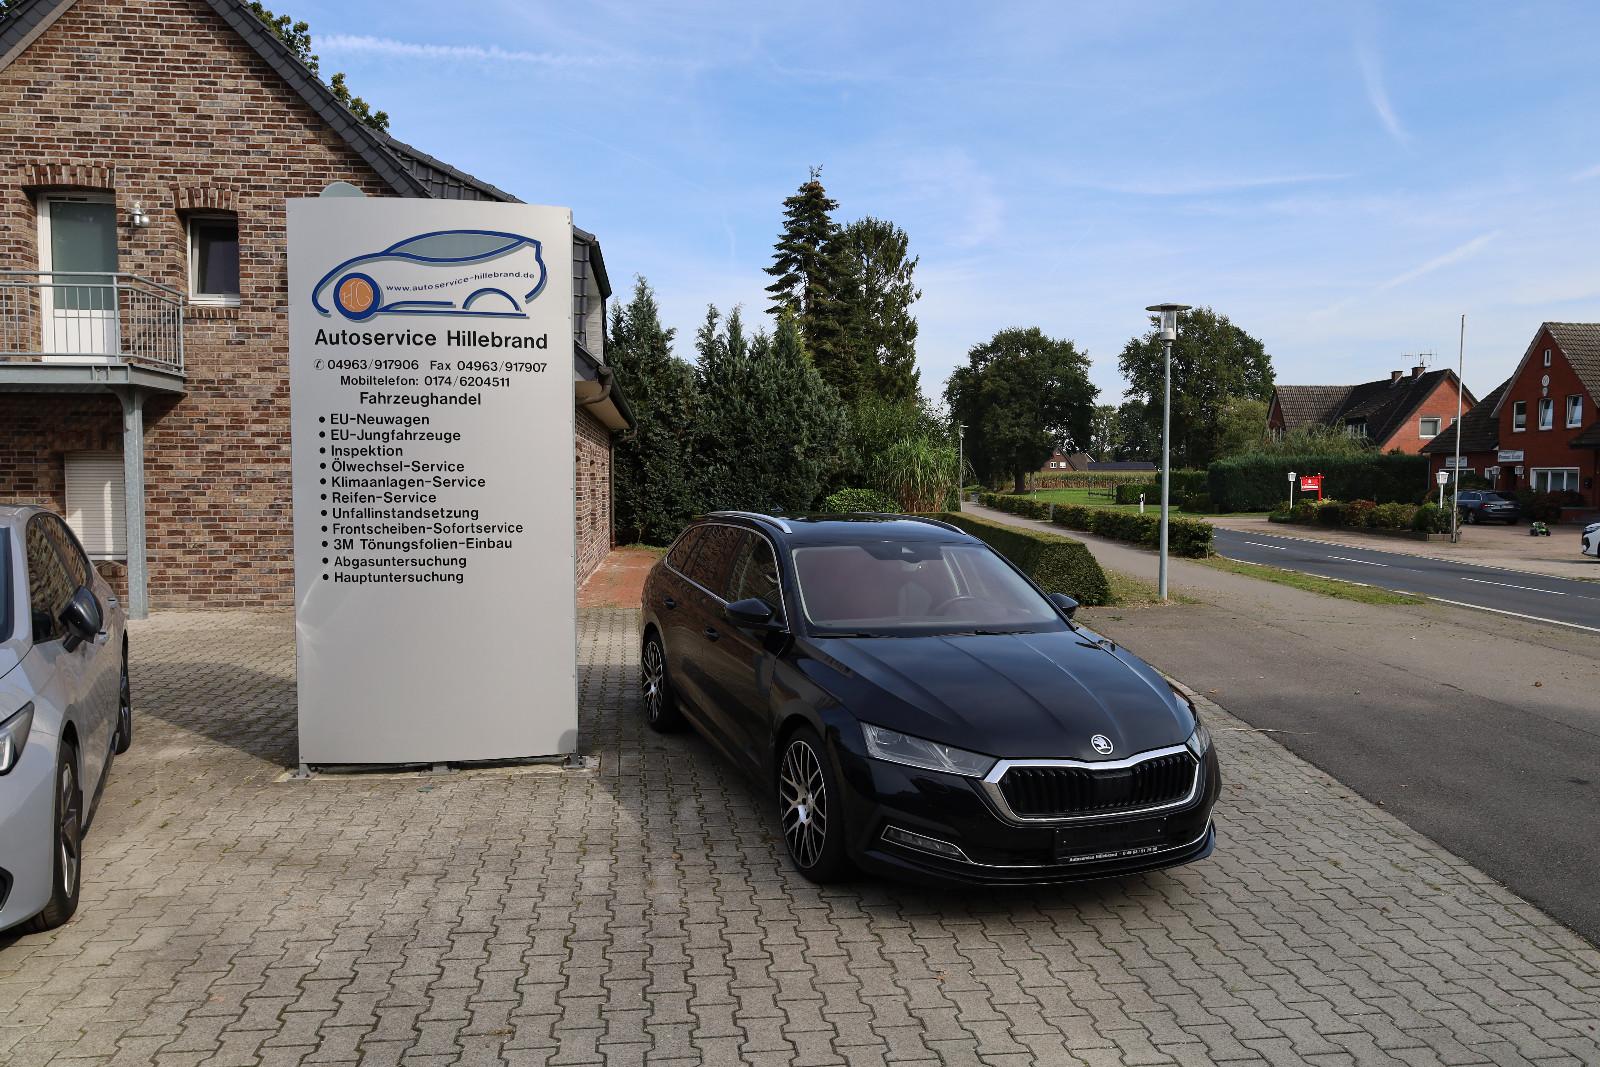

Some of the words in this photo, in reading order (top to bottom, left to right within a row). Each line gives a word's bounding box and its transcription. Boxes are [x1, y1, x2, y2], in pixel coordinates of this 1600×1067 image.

[386, 271, 535, 292] www.autoservice-hillebrand.de
[314, 328, 437, 347] Autoservice
[446, 329, 548, 350] Hillebrand
[327, 358, 420, 371] 04963/917906
[429, 359, 452, 371] Fax
[456, 360, 548, 373] 04963/917907
[340, 375, 420, 387] Mobiltelefon:
[424, 375, 511, 388] 0174/6204511
[359, 391, 482, 407] Fahrzeughandel
[330, 413, 430, 427] EU-Neuwagen
[330, 429, 462, 444] EU-Jungfahrzeuge
[331, 444, 404, 458] Inspektion
[331, 458, 466, 473] Ölwechsel-Service
[331, 475, 487, 489] Klimaanlagen-Service
[332, 491, 438, 504] Reifen-Service
[332, 507, 480, 521] Unfallinstandsetzung
[332, 521, 525, 535] Frontscheiben-Sofortservice
[333, 538, 354, 551] 3M
[359, 537, 514, 553] Tönungsfolien-Einbau
[333, 555, 468, 569] Abgasuntersuchung
[334, 571, 465, 585] Hauptuntersuchung
